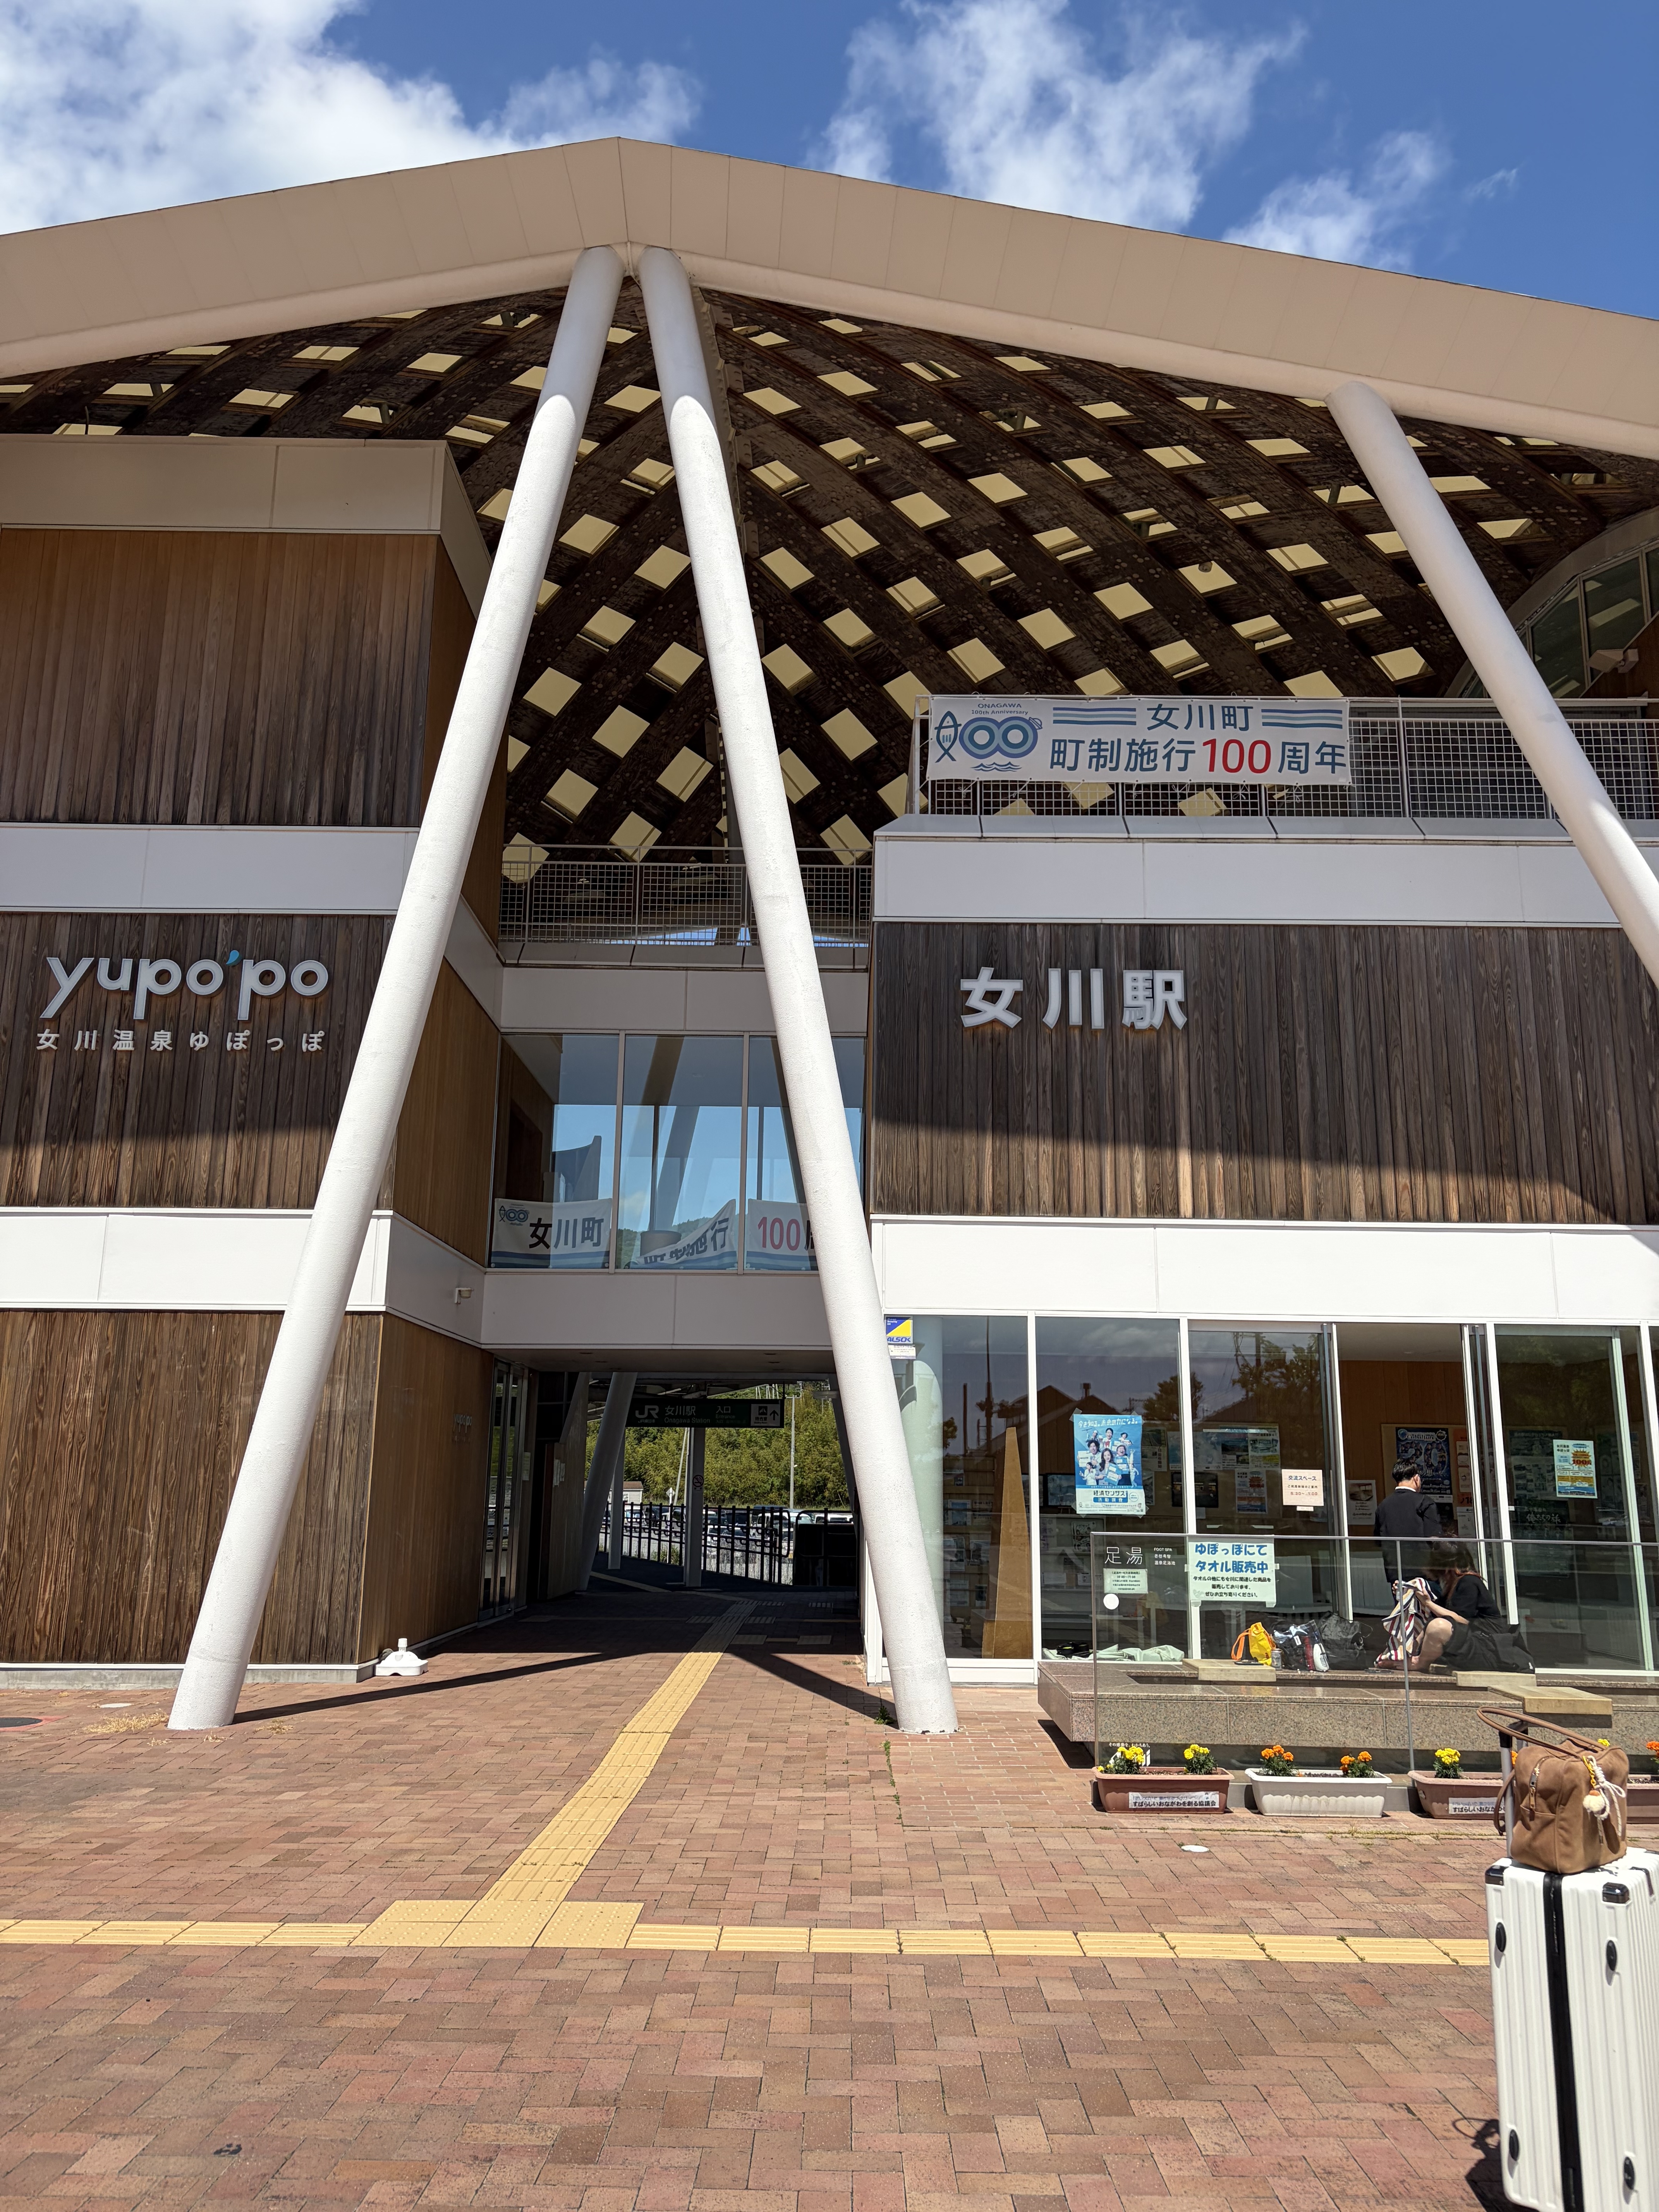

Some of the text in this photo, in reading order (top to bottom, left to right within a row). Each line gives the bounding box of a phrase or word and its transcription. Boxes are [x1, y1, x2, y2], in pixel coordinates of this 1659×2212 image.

[1147, 703, 1253, 732] 女川町
[1050, 738, 1346, 774] 町制施行100周年
[960, 967, 1187, 1030] 女川駅
[36, 1029, 325, 1052] 女川温泉ゆぽっぽ
[529, 1217, 604, 1249] 女川町
[635, 1405, 659, 1419] JR
[665, 1405, 696, 1416] 女川駅
[1104, 1547, 1143, 1565] 足湯
[1195, 1543, 1267, 1556] ゆぽっぽにて
[1195, 1560, 1268, 1574] タオル販売中
